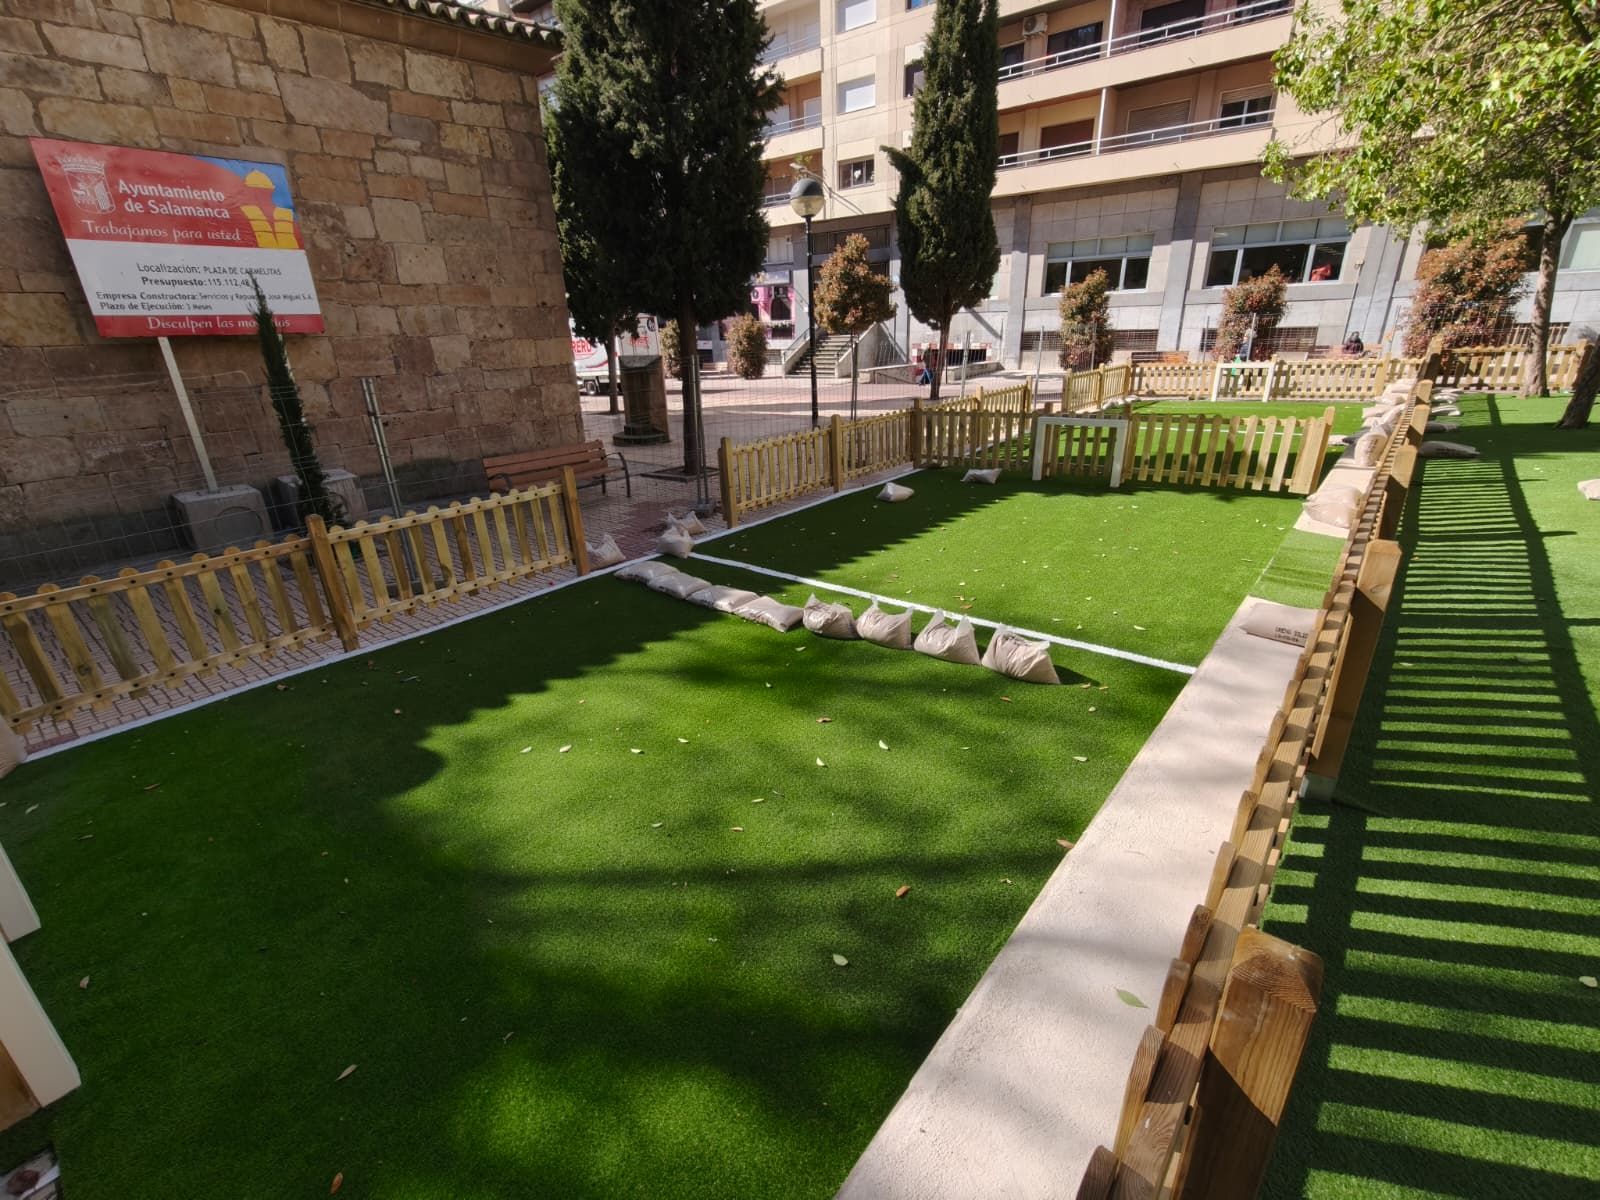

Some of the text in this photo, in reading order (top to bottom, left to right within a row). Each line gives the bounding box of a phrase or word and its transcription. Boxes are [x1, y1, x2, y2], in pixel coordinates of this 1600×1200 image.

[118, 178, 225, 202] Ayuntamiento
[123, 198, 230, 219] de Salamanca
[81, 219, 241, 242] Trabajamos para usted
[136, 262, 201, 274] Localización:
[203, 265, 227, 274] PLAZA
[228, 266, 239, 274] DE
[141, 276, 207, 288] Presupuesto:
[96, 291, 137, 301] Empresa
[100, 301, 126, 310] Plazo
[128, 301, 139, 310] de
[147, 315, 213, 334] Disculpen
[216, 315, 235, 328] las
